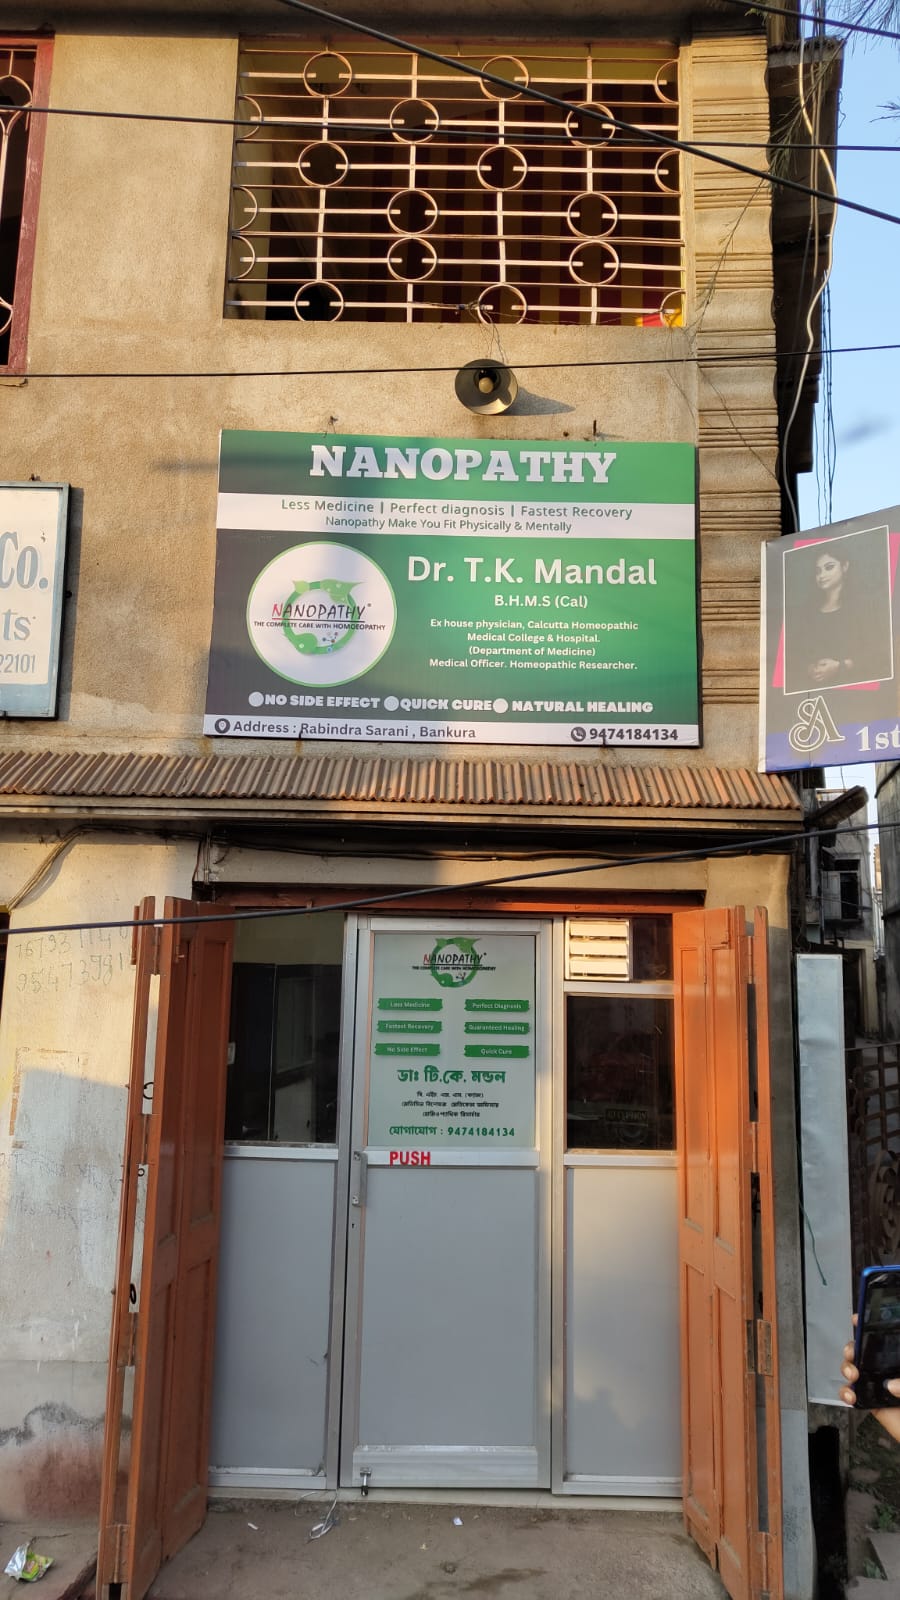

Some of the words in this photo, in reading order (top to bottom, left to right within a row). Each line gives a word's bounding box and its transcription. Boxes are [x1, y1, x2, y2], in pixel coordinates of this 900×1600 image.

[310, 445, 616, 483] NANOPATHY
[281, 499, 310, 510] Less
[314, 500, 374, 513] Medicine
[390, 502, 437, 514] Perfect
[441, 502, 505, 517] diagnosis
[521, 505, 568, 517] Fastest
[572, 506, 632, 520] Recovery
[325, 516, 386, 530] Nanopathy
[388, 517, 417, 528] Make
[420, 519, 441, 529] You
[444, 519, 456, 529] Fit
[459, 520, 511, 532] Physically
[514, 521, 522, 530] &
[526, 521, 572, 533] Mentally
[408, 555, 454, 582] Dr.
[463, 557, 524, 583] T.K.
[534, 558, 657, 585] Mandal
[494, 594, 551, 607] B.H.M.S
[555, 595, 588, 609] (Cal)
[271, 603, 366, 619] NANOPATHY
[430, 618, 442, 627] Ex
[444, 619, 473, 628] house
[475, 620, 526, 630] physician,
[527, 620, 569, 629] Calcutta
[571, 621, 639, 631] Homeopathic
[467, 633, 506, 641] Medical
[508, 633, 545, 644] College
[547, 634, 554, 642] &
[556, 634, 601, 644] Hospital.
[468, 646, 532, 656] (Department
[534, 647, 545, 656] of
[547, 647, 596, 657] Medicine)
[429, 658, 468, 667] Medical
[470, 659, 508, 668] Officer.
[509, 660, 577, 670] Homeopathic
[579, 661, 638, 670] Researcher.
[264, 694, 288, 706] NO
[289, 695, 324, 707] SIDE
[326, 696, 381, 709] EFFECT
[400, 697, 449, 711] QUICK
[451, 699, 493, 711] CURE
[512, 700, 584, 713] NATURAL
[587, 701, 654, 713] HEALING
[233, 721, 289, 734] Address
[300, 722, 362, 735] Rabindra
[365, 724, 409, 737] Sarani
[419, 726, 476, 738] Bankura
[589, 728, 679, 741] 9474184134
[423, 953, 484, 966] NANOPATHY
[447, 1127, 515, 1137] 9474184134
[389, 1151, 431, 1166] PUSH
